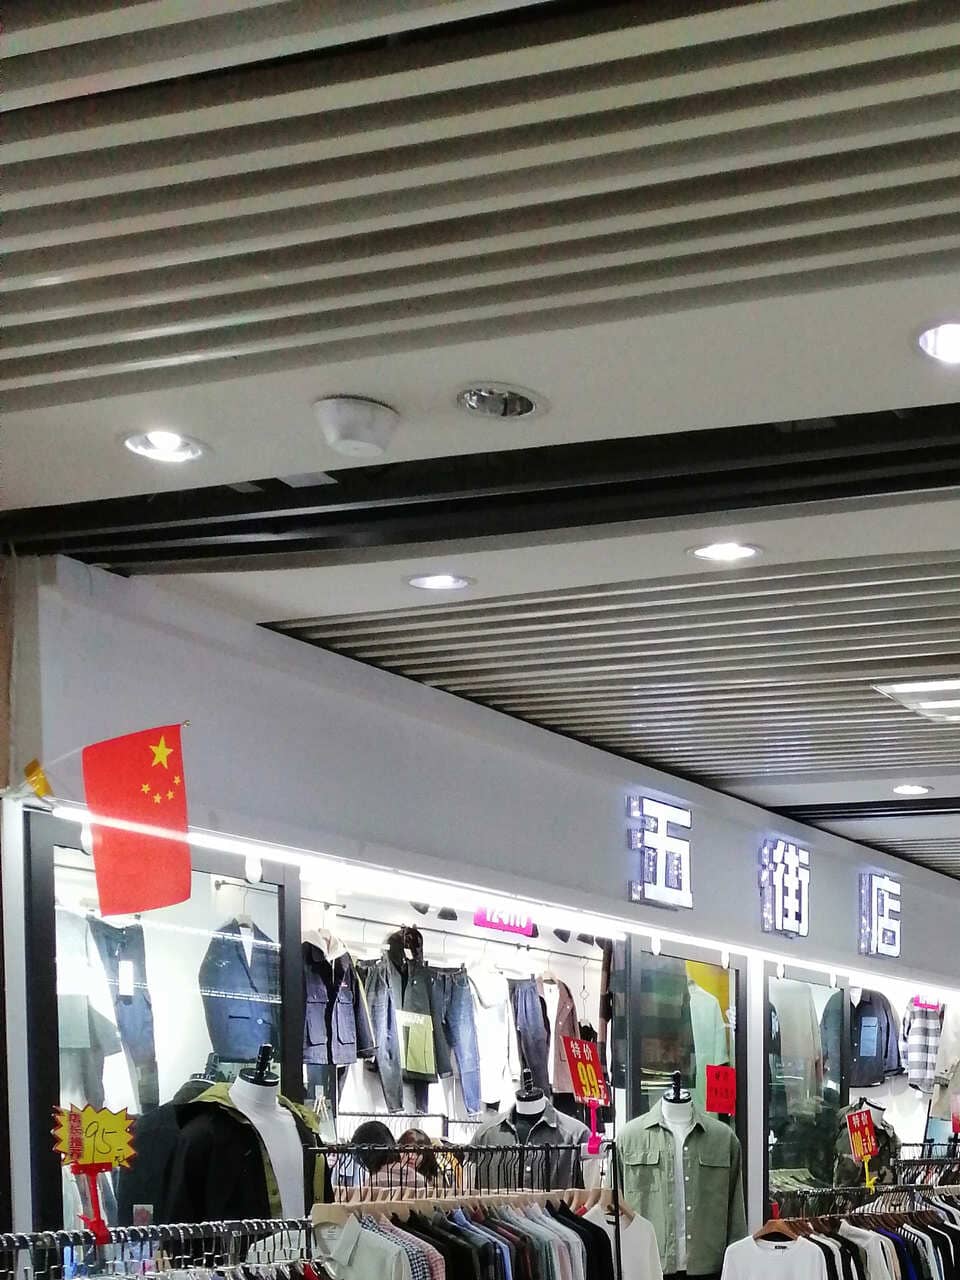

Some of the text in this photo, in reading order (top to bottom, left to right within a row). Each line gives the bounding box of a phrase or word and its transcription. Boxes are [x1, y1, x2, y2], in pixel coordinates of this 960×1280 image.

[628, 796, 901, 958] 五街店
[570, 1040, 592, 1061] 特价
[852, 1112, 869, 1128] 特价
